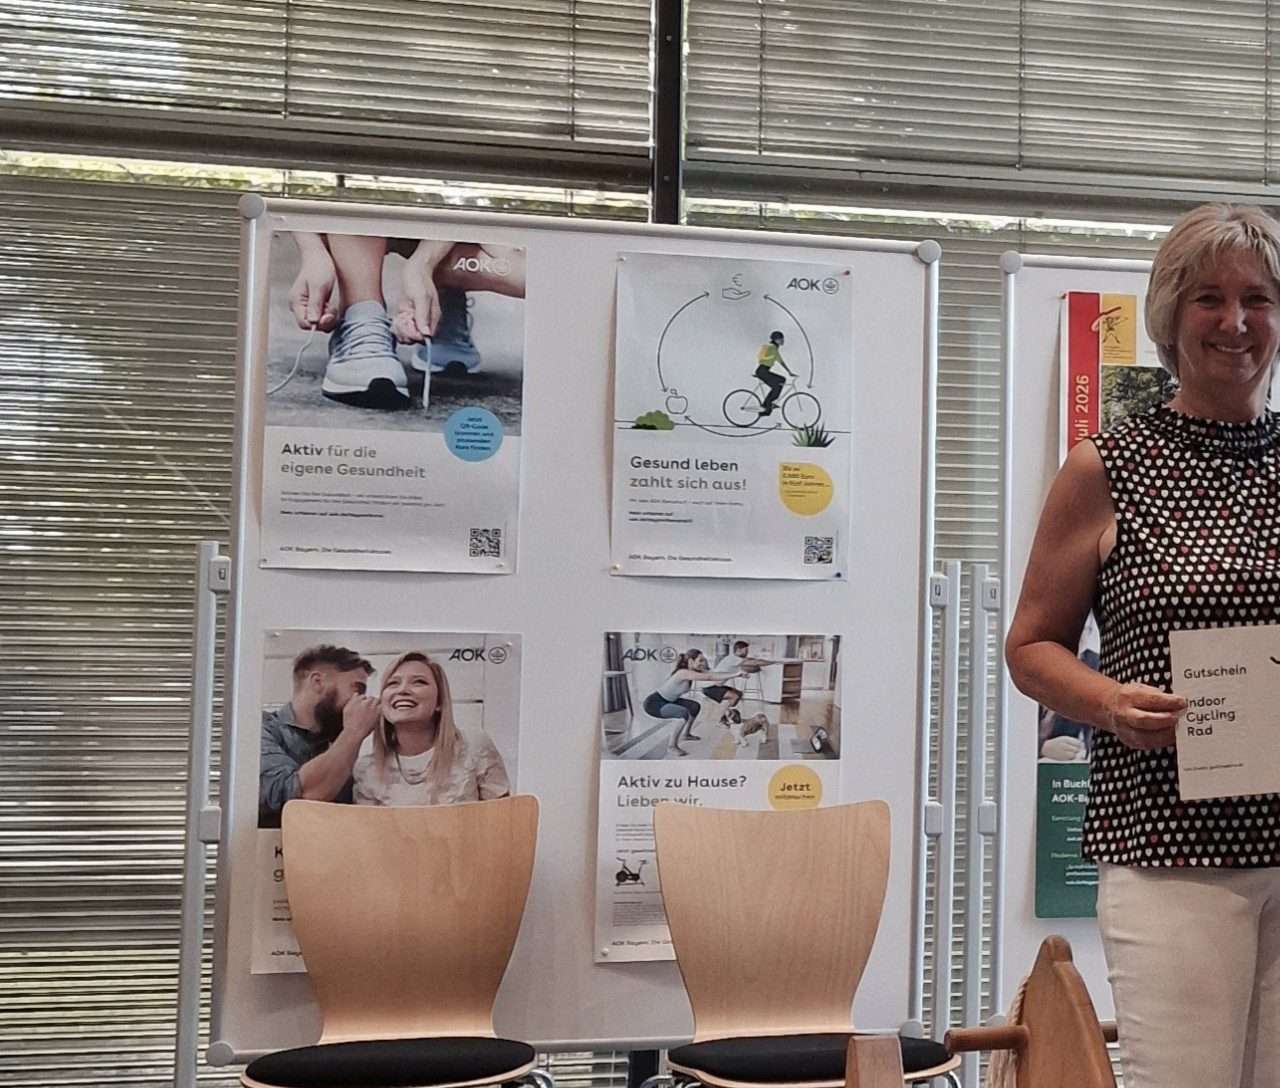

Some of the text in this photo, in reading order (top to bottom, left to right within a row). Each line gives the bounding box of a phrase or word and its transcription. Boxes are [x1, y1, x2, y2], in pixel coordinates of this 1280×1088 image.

[453, 257, 491, 272] AOK
[786, 278, 822, 291] AOK
[1075, 375, 1089, 413] 2026
[281, 443, 377, 458] Aktiv für die
[280, 463, 427, 479] eigene Gesundheit
[630, 456, 738, 471] Gesund leben
[629, 476, 747, 491] zahlt sich aus!
[449, 648, 486, 661] AOK
[621, 648, 657, 661] AOK
[1183, 664, 1247, 679] Gutschein
[1186, 697, 1226, 708] Indoor
[1186, 709, 1236, 724] Cycling
[1187, 725, 1213, 736] Rad
[617, 775, 747, 788] Aktiv zu Hause?
[780, 783, 811, 791] Jetzt
